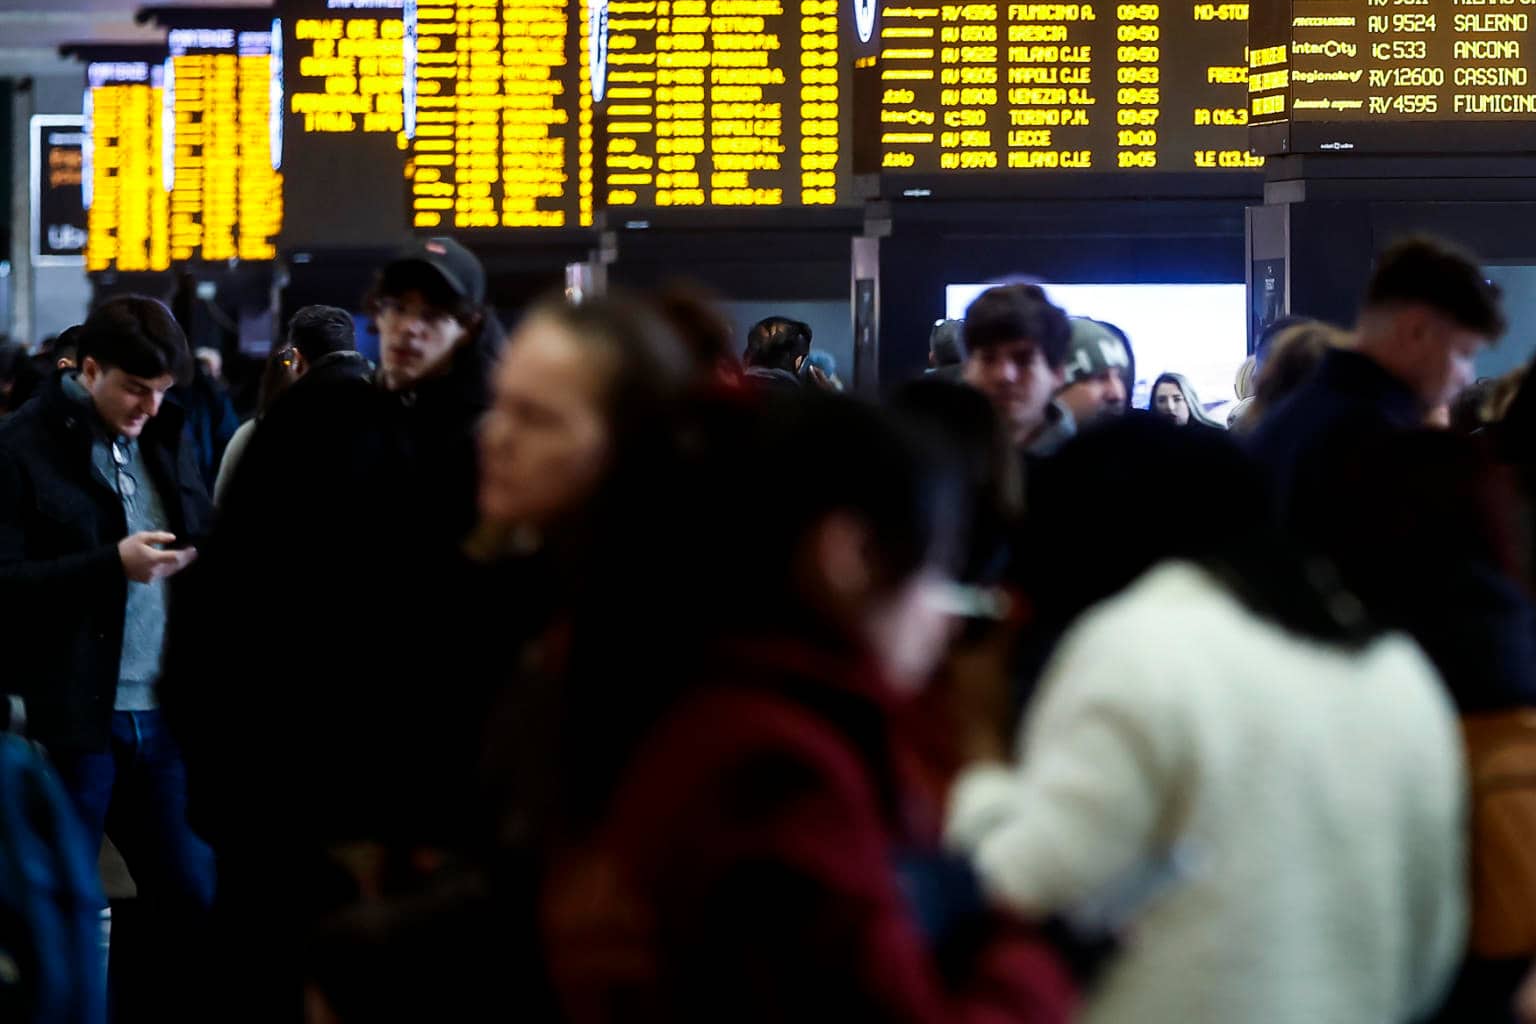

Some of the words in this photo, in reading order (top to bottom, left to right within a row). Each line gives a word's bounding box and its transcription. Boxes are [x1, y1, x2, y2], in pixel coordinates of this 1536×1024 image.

[1368, 15, 1389, 34] AV
[1392, 13, 1437, 33] 9524
[1453, 13, 1528, 32] SALERNO
[1392, 40, 1427, 59] 533
[1453, 40, 1520, 59] ANCONA
[1368, 69, 1392, 88] RV
[1390, 64, 1445, 87] 12600
[1453, 67, 1528, 87] CASSINO
[1368, 96, 1392, 114] RV
[1390, 94, 1438, 113] 4595
